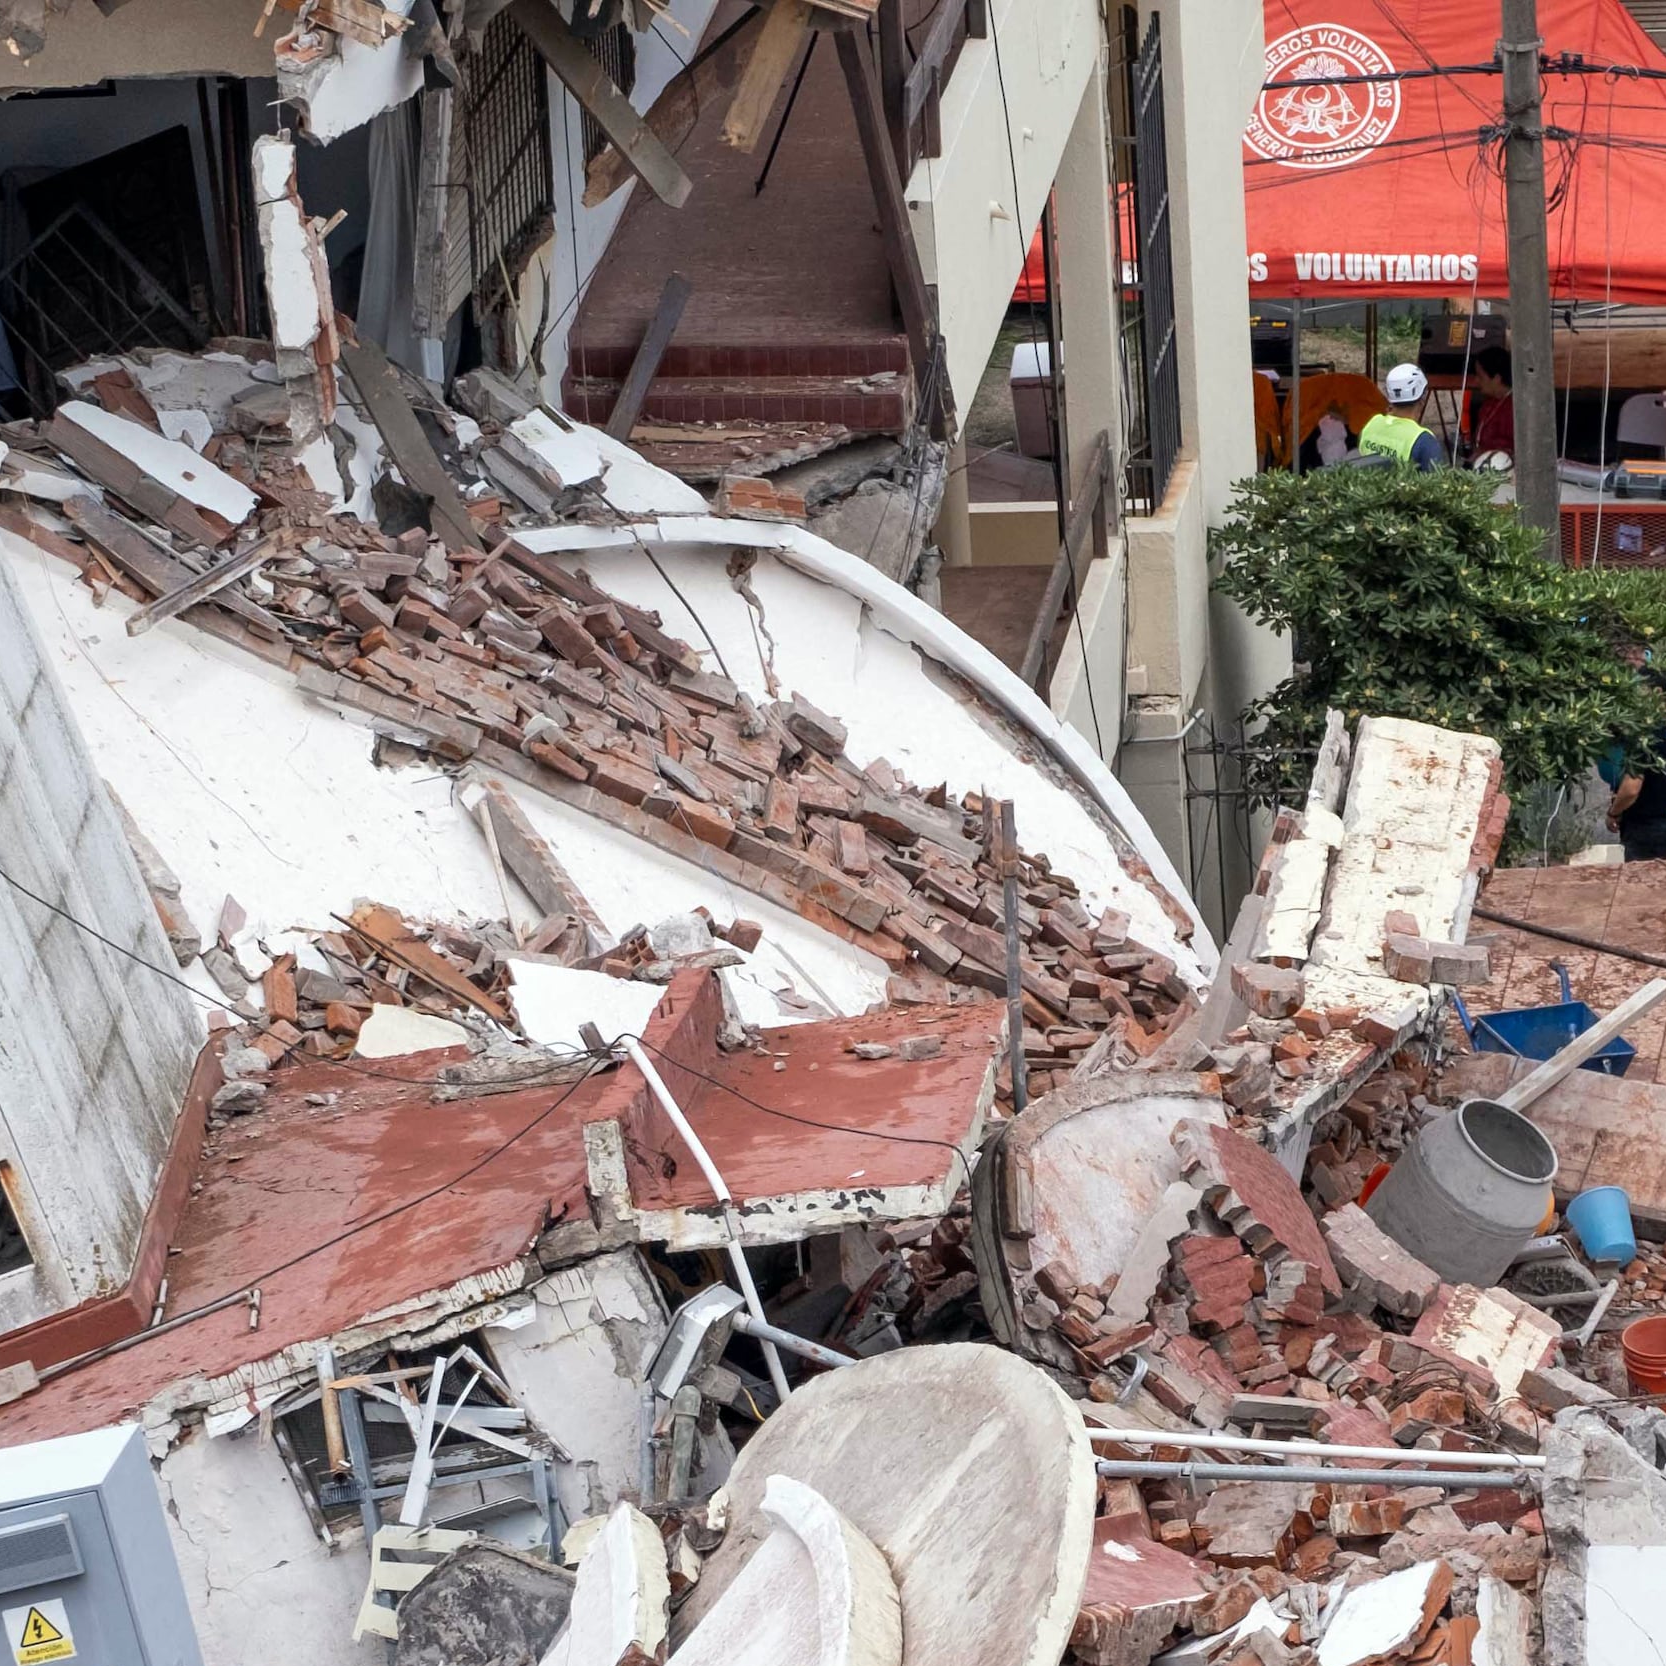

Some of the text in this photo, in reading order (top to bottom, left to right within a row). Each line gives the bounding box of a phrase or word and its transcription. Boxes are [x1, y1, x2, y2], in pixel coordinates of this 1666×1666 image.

[1317, 30, 1393, 108] VOLUNTAIOS
[1300, 117, 1388, 163] RODRIGUEZ
[1294, 252, 1478, 283] VOLUNTARIOS
